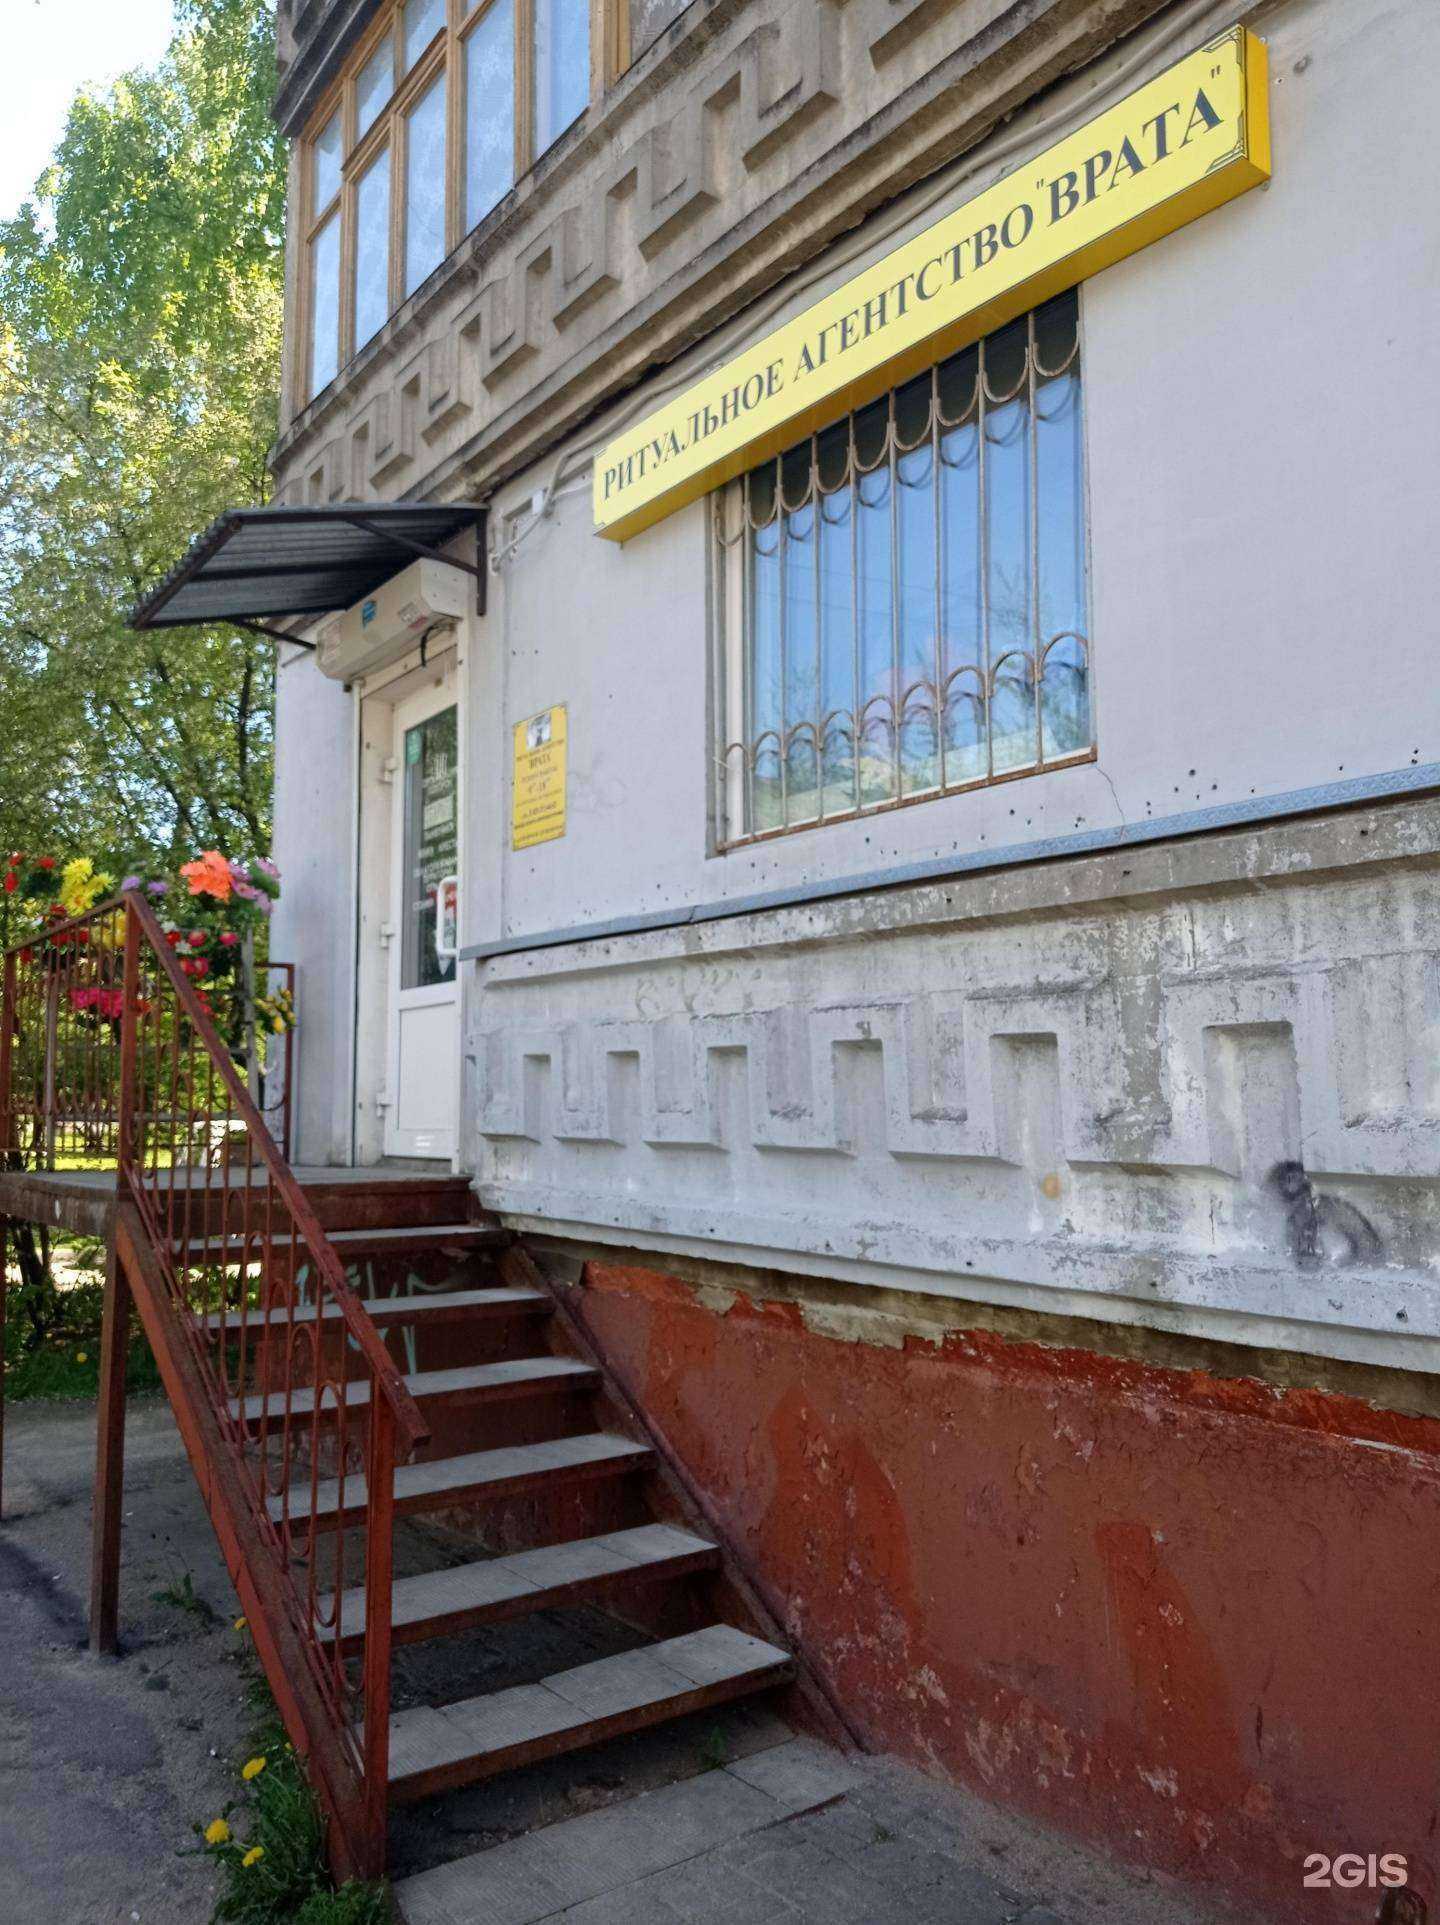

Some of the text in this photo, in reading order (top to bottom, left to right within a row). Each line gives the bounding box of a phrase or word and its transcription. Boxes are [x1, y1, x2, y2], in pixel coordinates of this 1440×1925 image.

[602, 65, 1223, 500] РИТУАЛЬНОЕ АГЕНТСТВО "ВРАТА"
